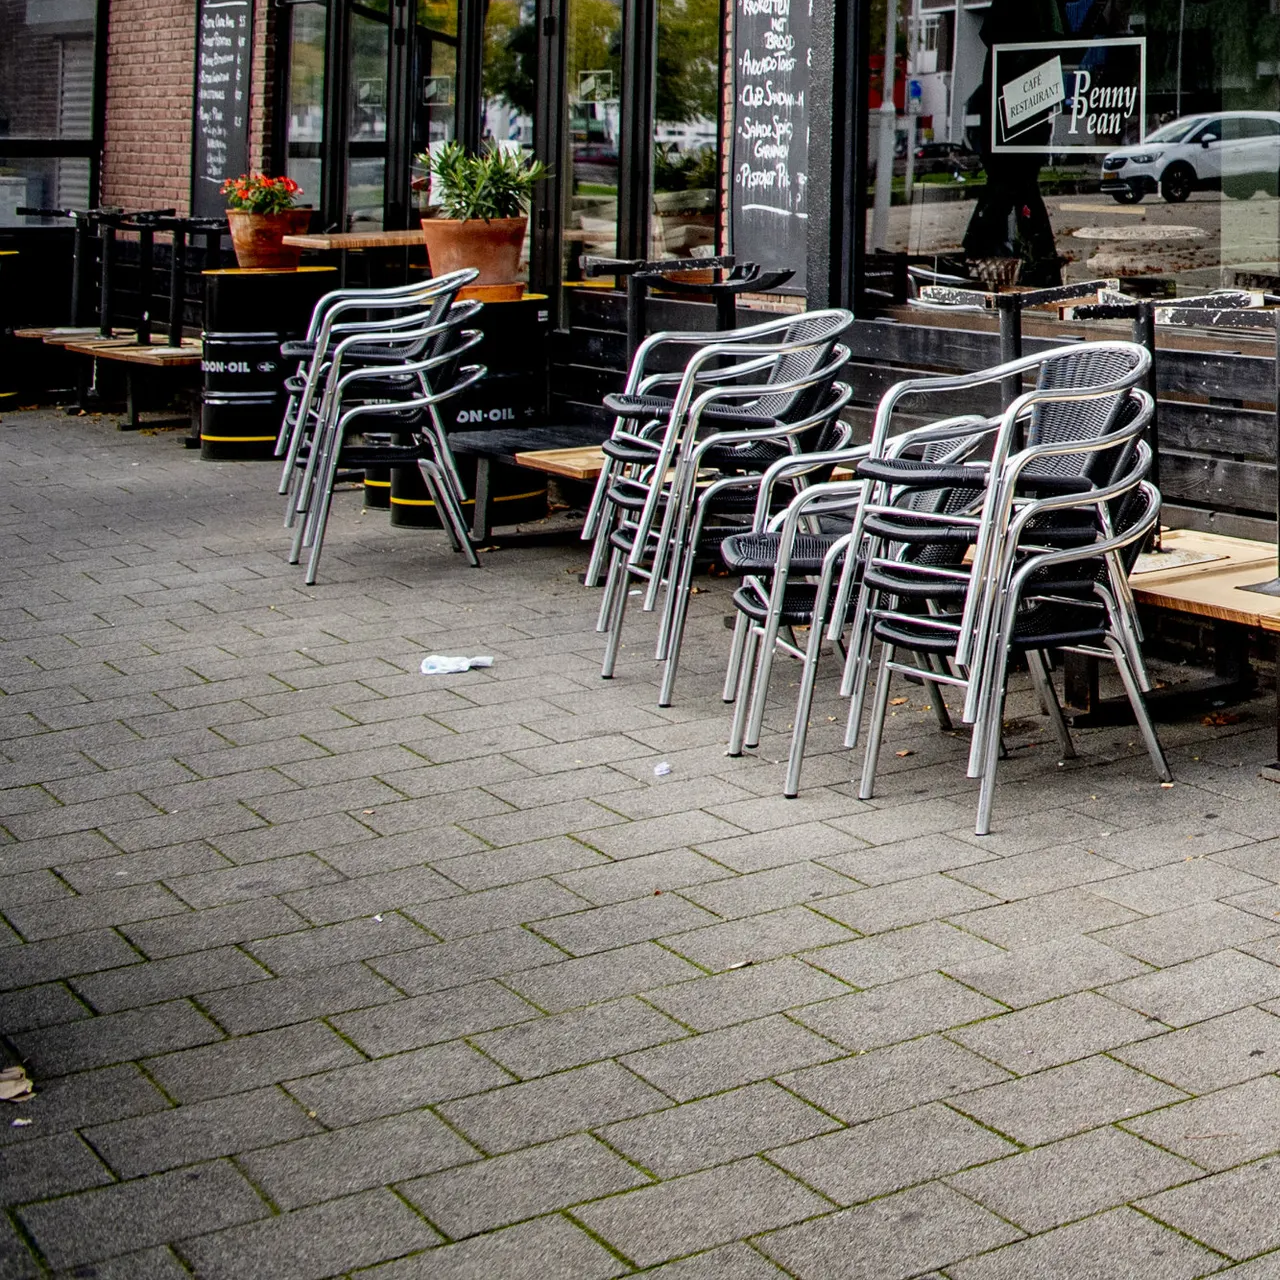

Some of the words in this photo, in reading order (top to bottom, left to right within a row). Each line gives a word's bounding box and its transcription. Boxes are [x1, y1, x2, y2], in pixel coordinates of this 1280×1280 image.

[1010, 82, 1060, 118] RESTAURANT
[1022, 71, 1042, 94] CAFÉ
[1070, 70, 1138, 118] Penny
[1067, 96, 1122, 135] Pean
